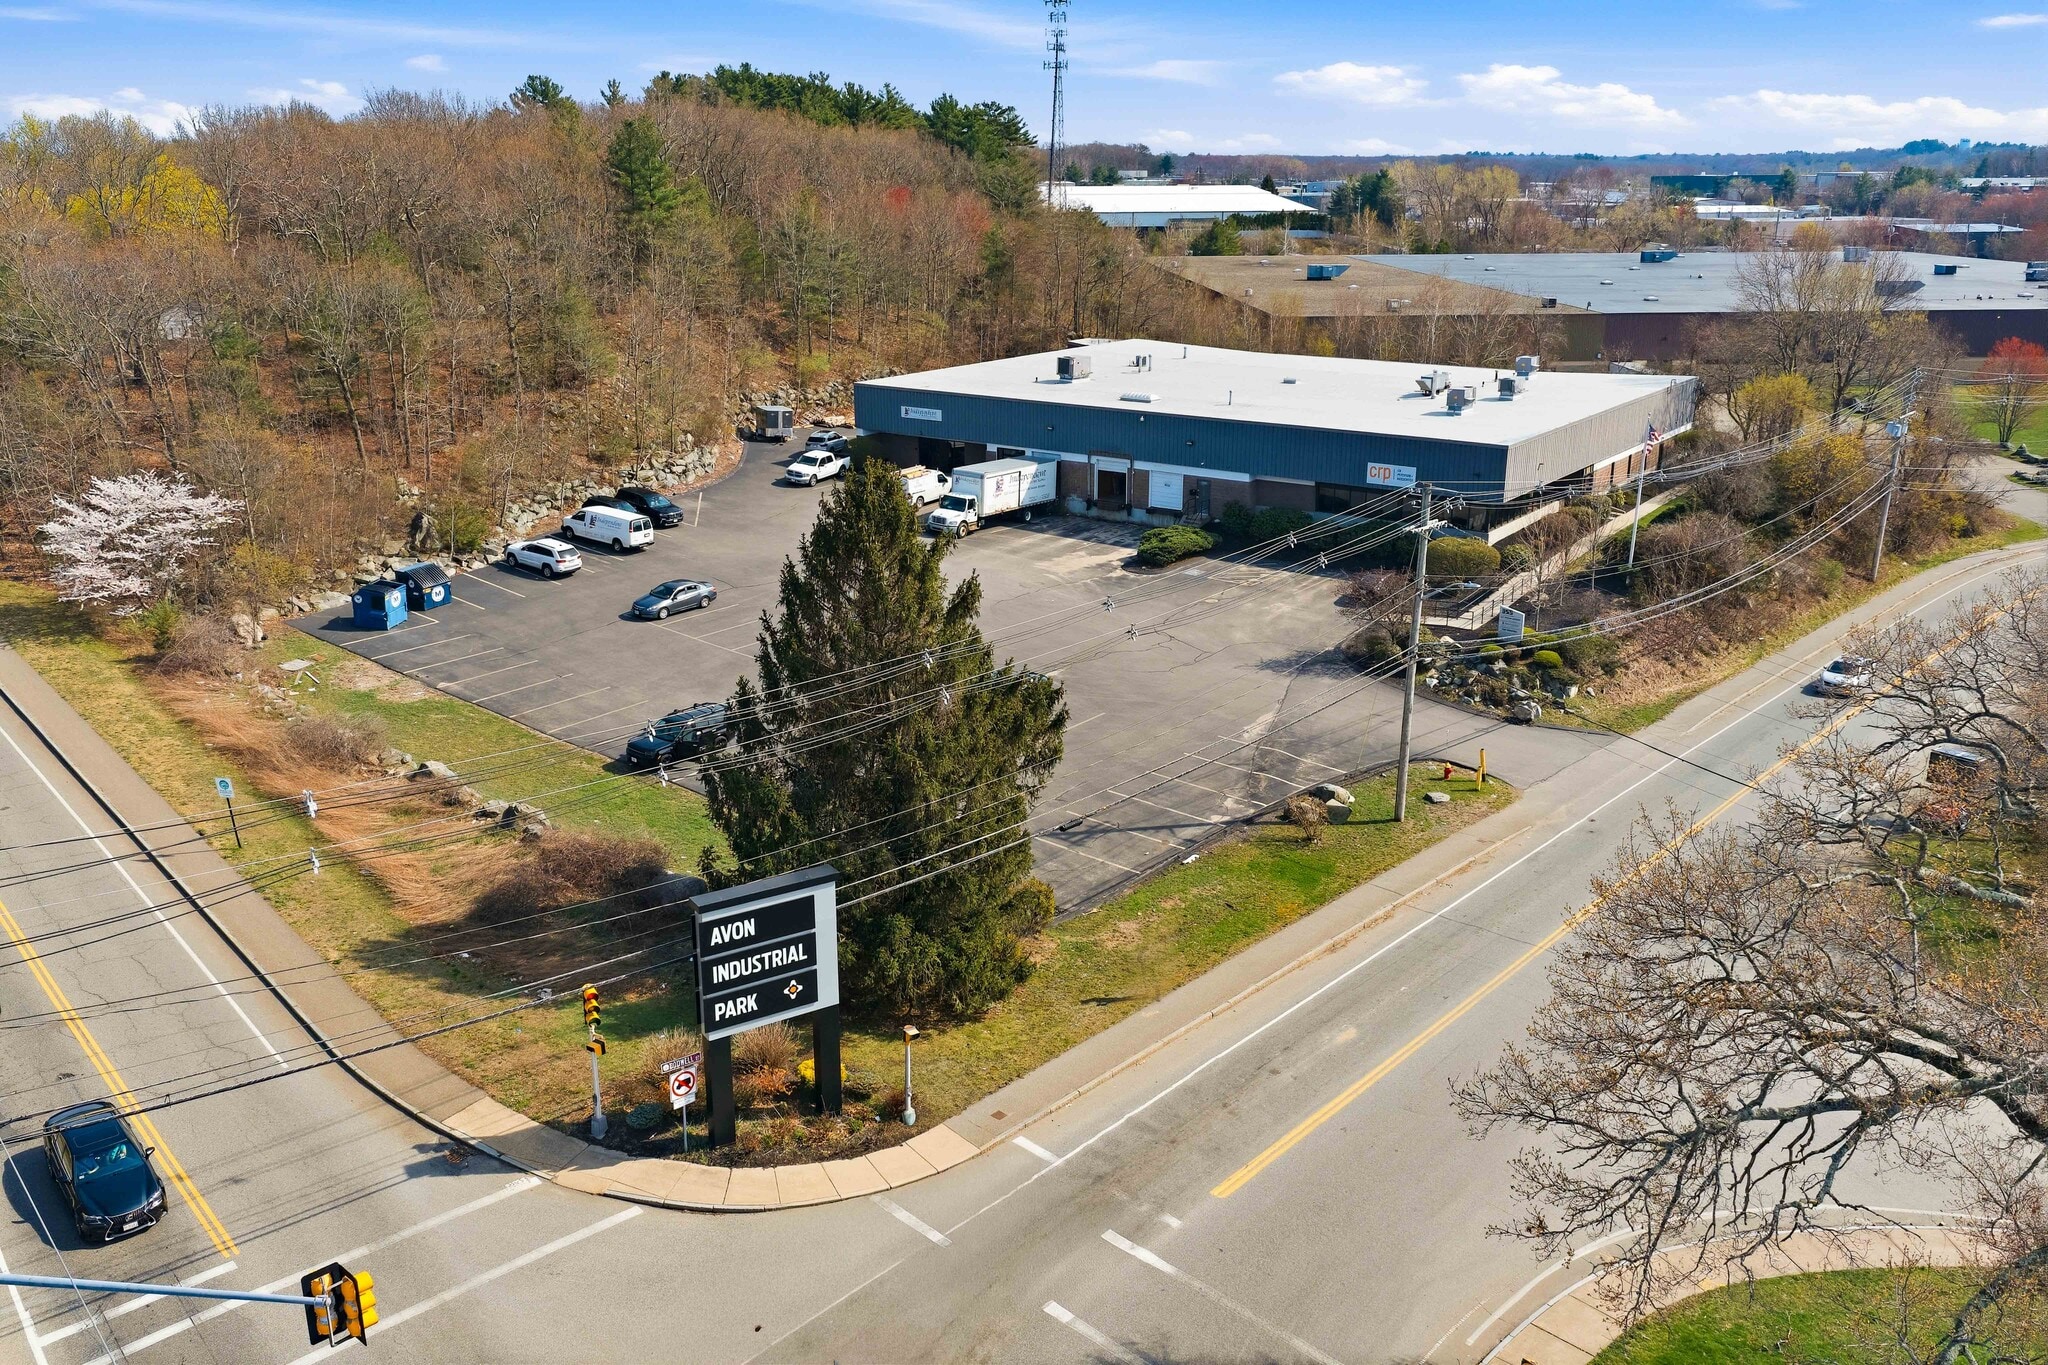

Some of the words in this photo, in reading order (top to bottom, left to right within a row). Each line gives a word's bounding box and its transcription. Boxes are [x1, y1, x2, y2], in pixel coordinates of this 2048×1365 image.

[1369, 465, 1391, 483] crp
[710, 918, 755, 946] AVON
[712, 943, 807, 984] INDUSTRIAL
[714, 993, 758, 1022] PARK
